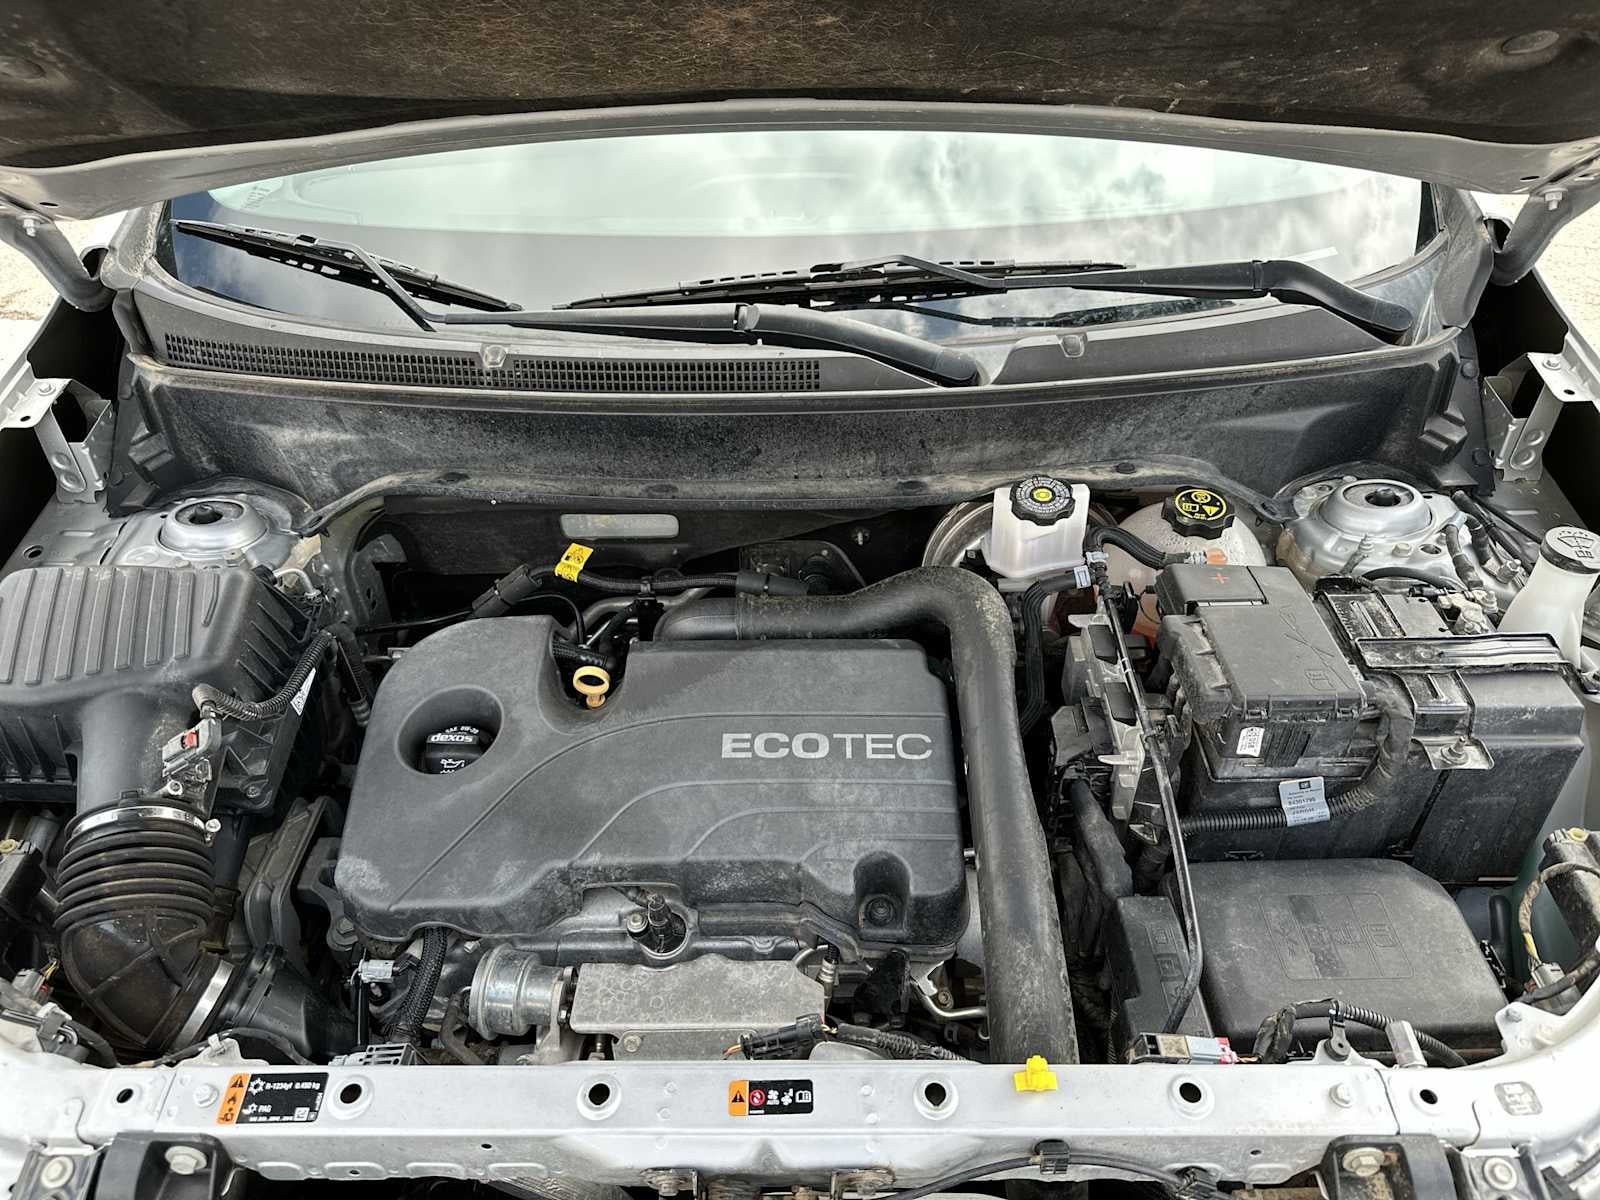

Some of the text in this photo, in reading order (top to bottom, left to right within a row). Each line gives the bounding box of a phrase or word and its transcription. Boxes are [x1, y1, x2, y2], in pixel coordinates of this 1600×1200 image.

[431, 733, 473, 743] dexos
[721, 732, 933, 760] ECOTEC
[258, 1105, 273, 1113] PAG
